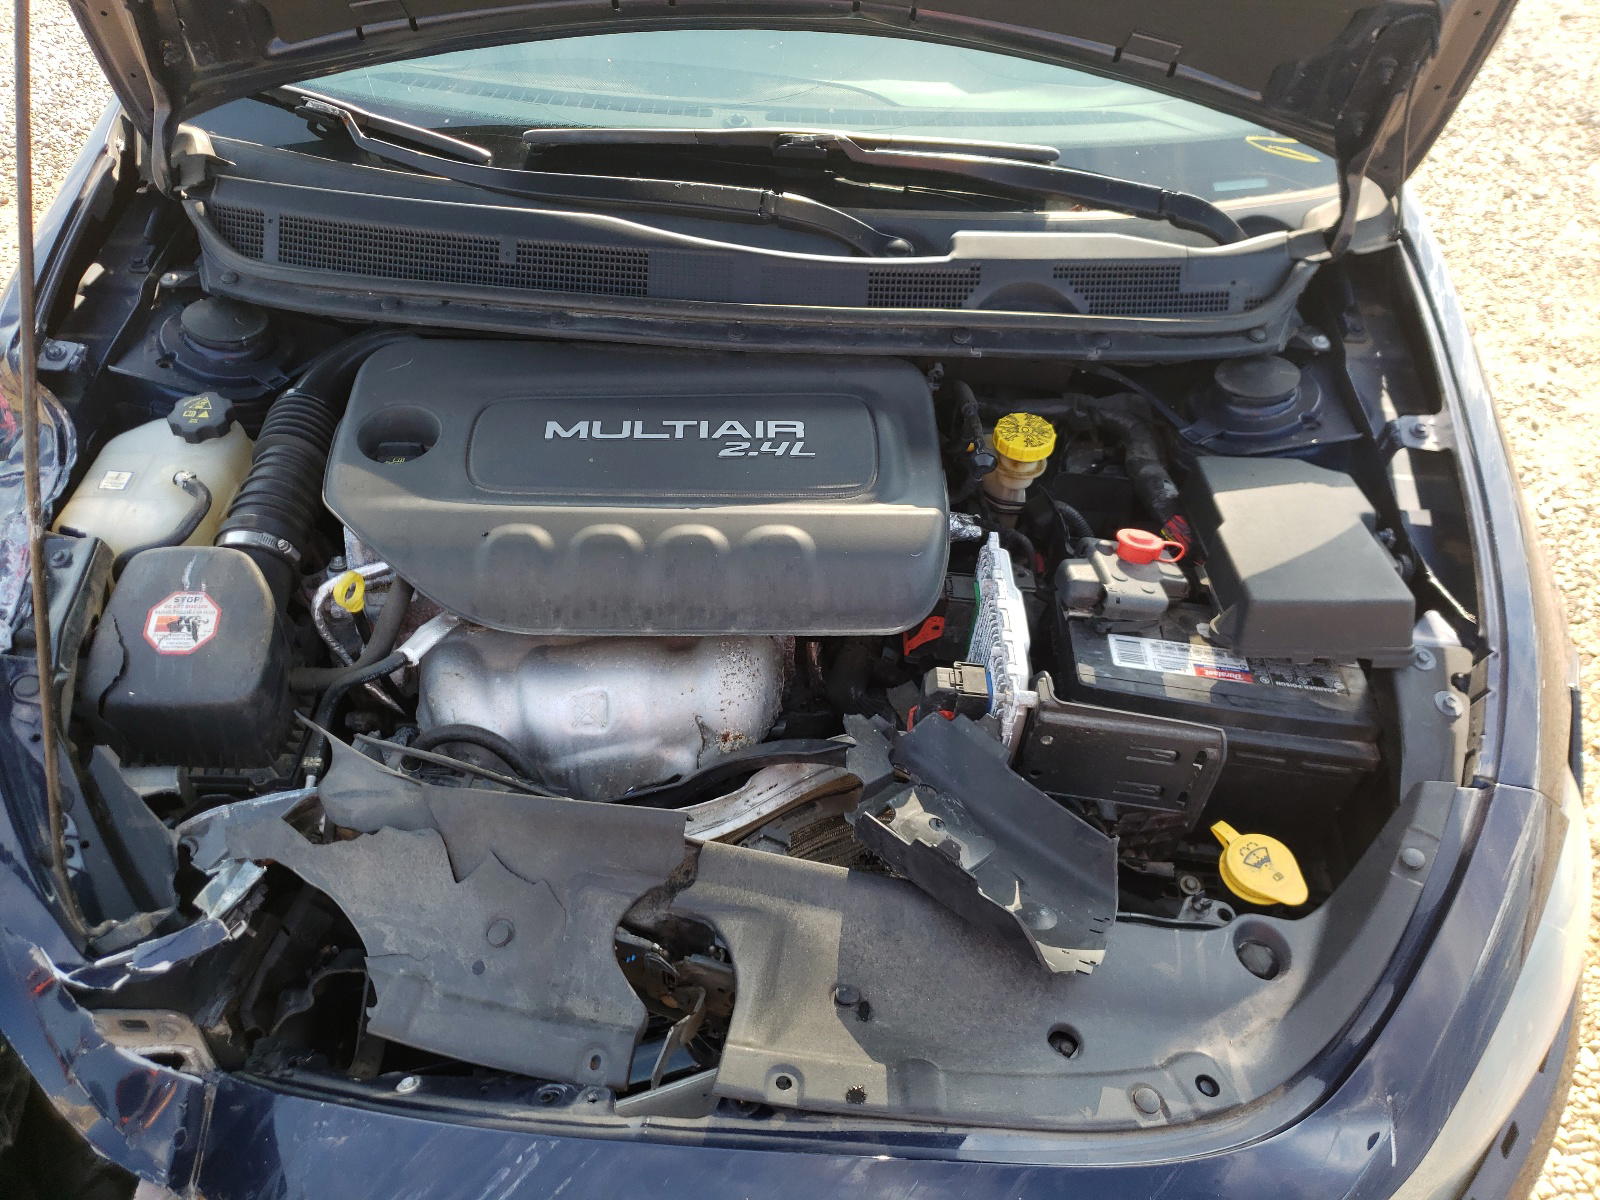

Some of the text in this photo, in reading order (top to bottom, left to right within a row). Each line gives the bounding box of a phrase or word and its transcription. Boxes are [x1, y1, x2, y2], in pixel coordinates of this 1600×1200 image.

[545, 420, 805, 440] MULTIAIR
[717, 441, 816, 457] 2.4L
[1204, 669, 1244, 681] Duralast
